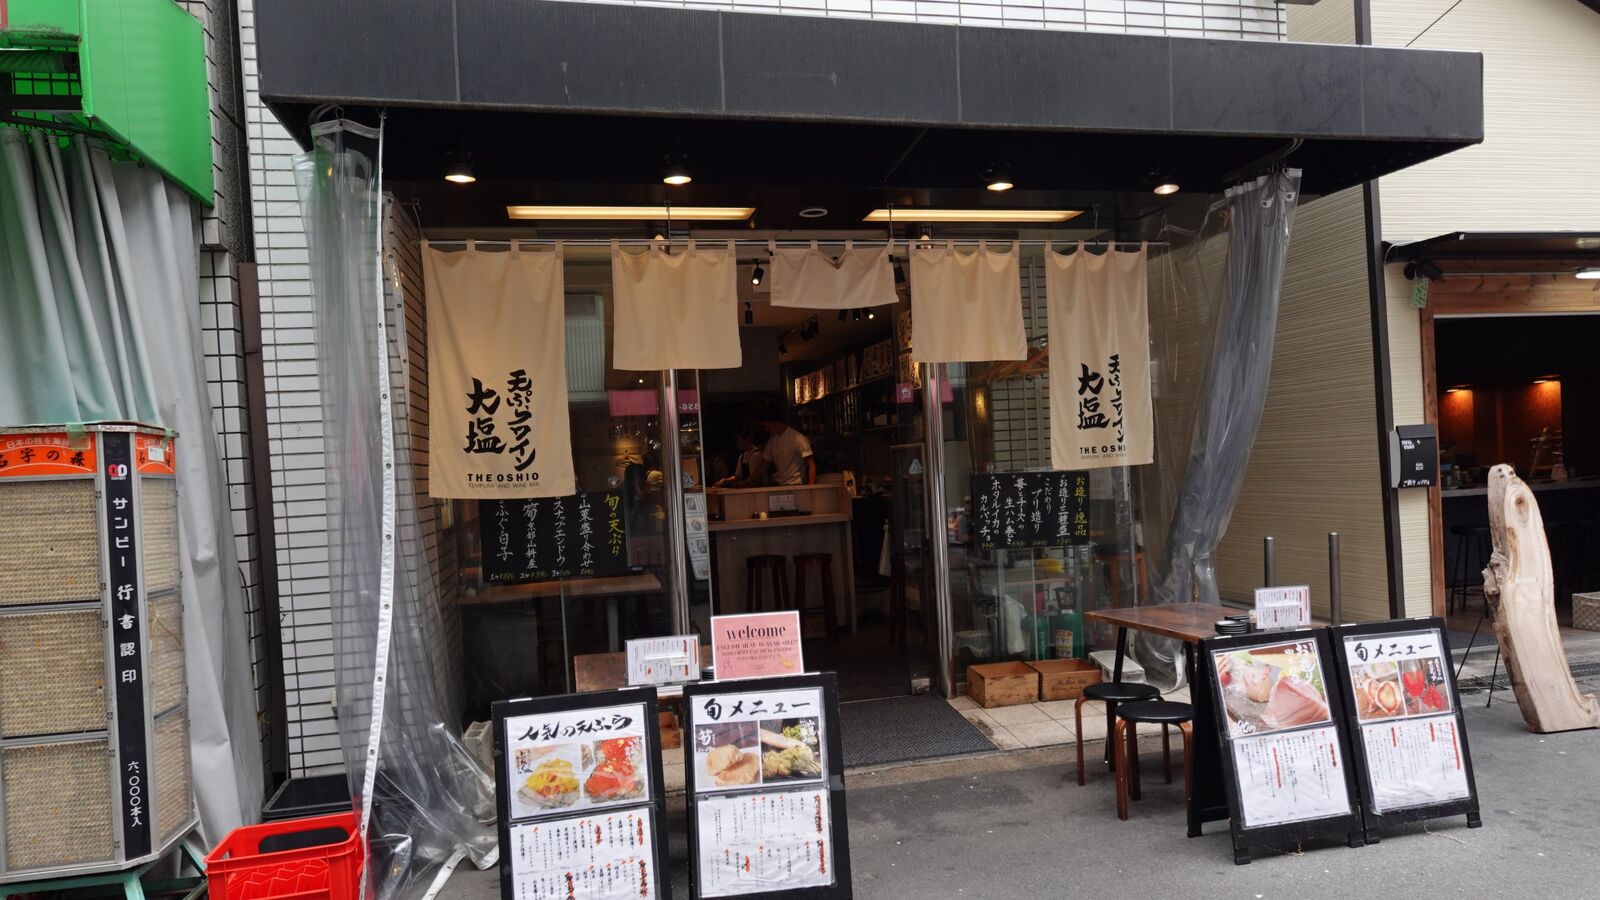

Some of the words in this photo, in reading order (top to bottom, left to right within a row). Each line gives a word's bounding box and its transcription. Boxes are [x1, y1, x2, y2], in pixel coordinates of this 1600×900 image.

[463, 377, 507, 455] 大塩
[1077, 363, 1110, 430] 大塩
[506, 369, 536, 472] 天ぷらワイン
[1080, 446, 1097, 455] THE
[467, 473, 493, 483] THE
[497, 472, 540, 482] OSHIO
[1044, 478, 1053, 515] こだわり
[604, 494, 625, 557] 旬の天ぷら
[980, 495, 991, 541] カルパッチョ
[991, 479, 1002, 535] ホタルイカの
[1004, 497, 1016, 545] 生ハム巻き
[495, 504, 514, 562] ふぐ白子
[551, 500, 568, 566] スナップエンドウ
[726, 625, 786, 640] welcome
[1354, 642, 1433, 662] 旬メニュー
[517, 714, 633, 742] 人気の天ぷら
[703, 697, 811, 721] 旬メニュー
